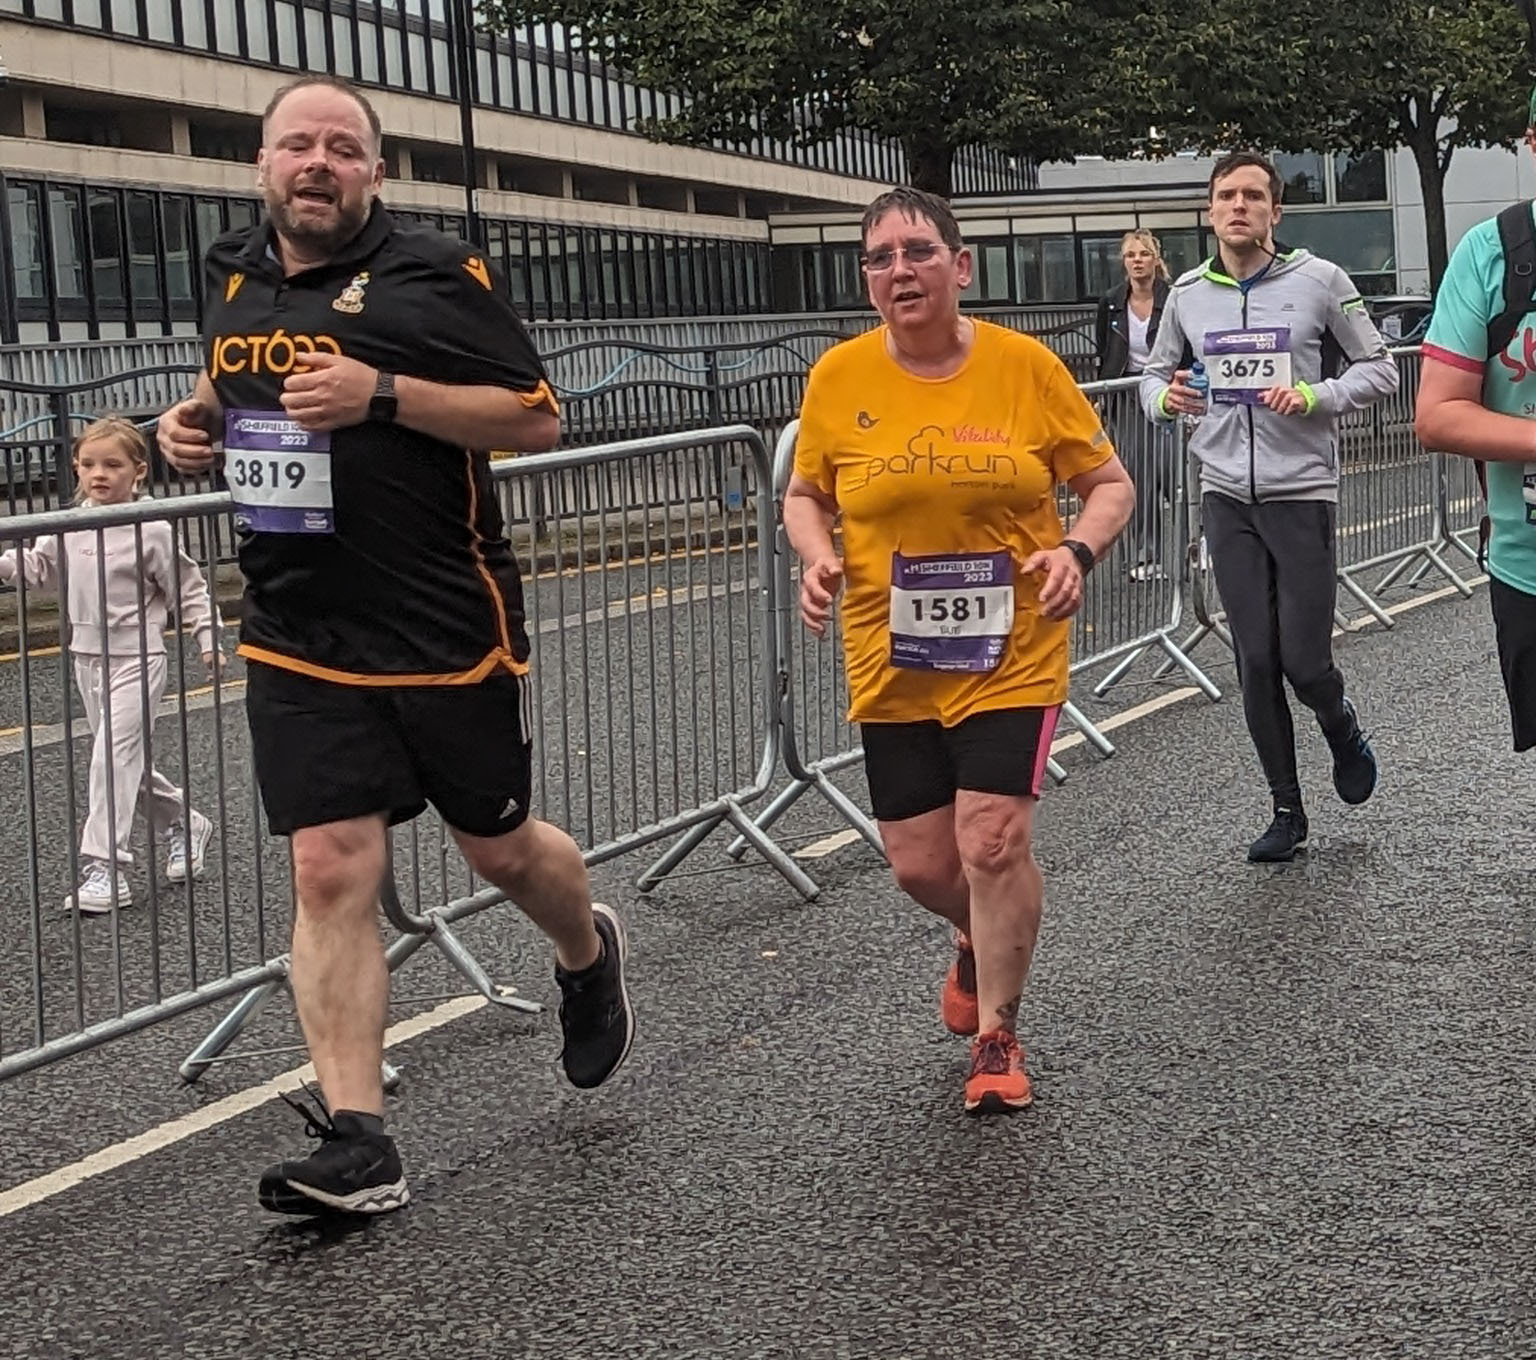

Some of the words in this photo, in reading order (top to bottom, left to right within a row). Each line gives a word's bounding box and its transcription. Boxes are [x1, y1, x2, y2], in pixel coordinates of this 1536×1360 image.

[1222, 359, 1274, 377] 3675
[280, 434, 308, 446] 2023
[234, 458, 306, 490] 3819
[866, 443, 1018, 486] parkrun
[963, 572, 993, 583] 2023
[911, 596, 986, 621] 1581
